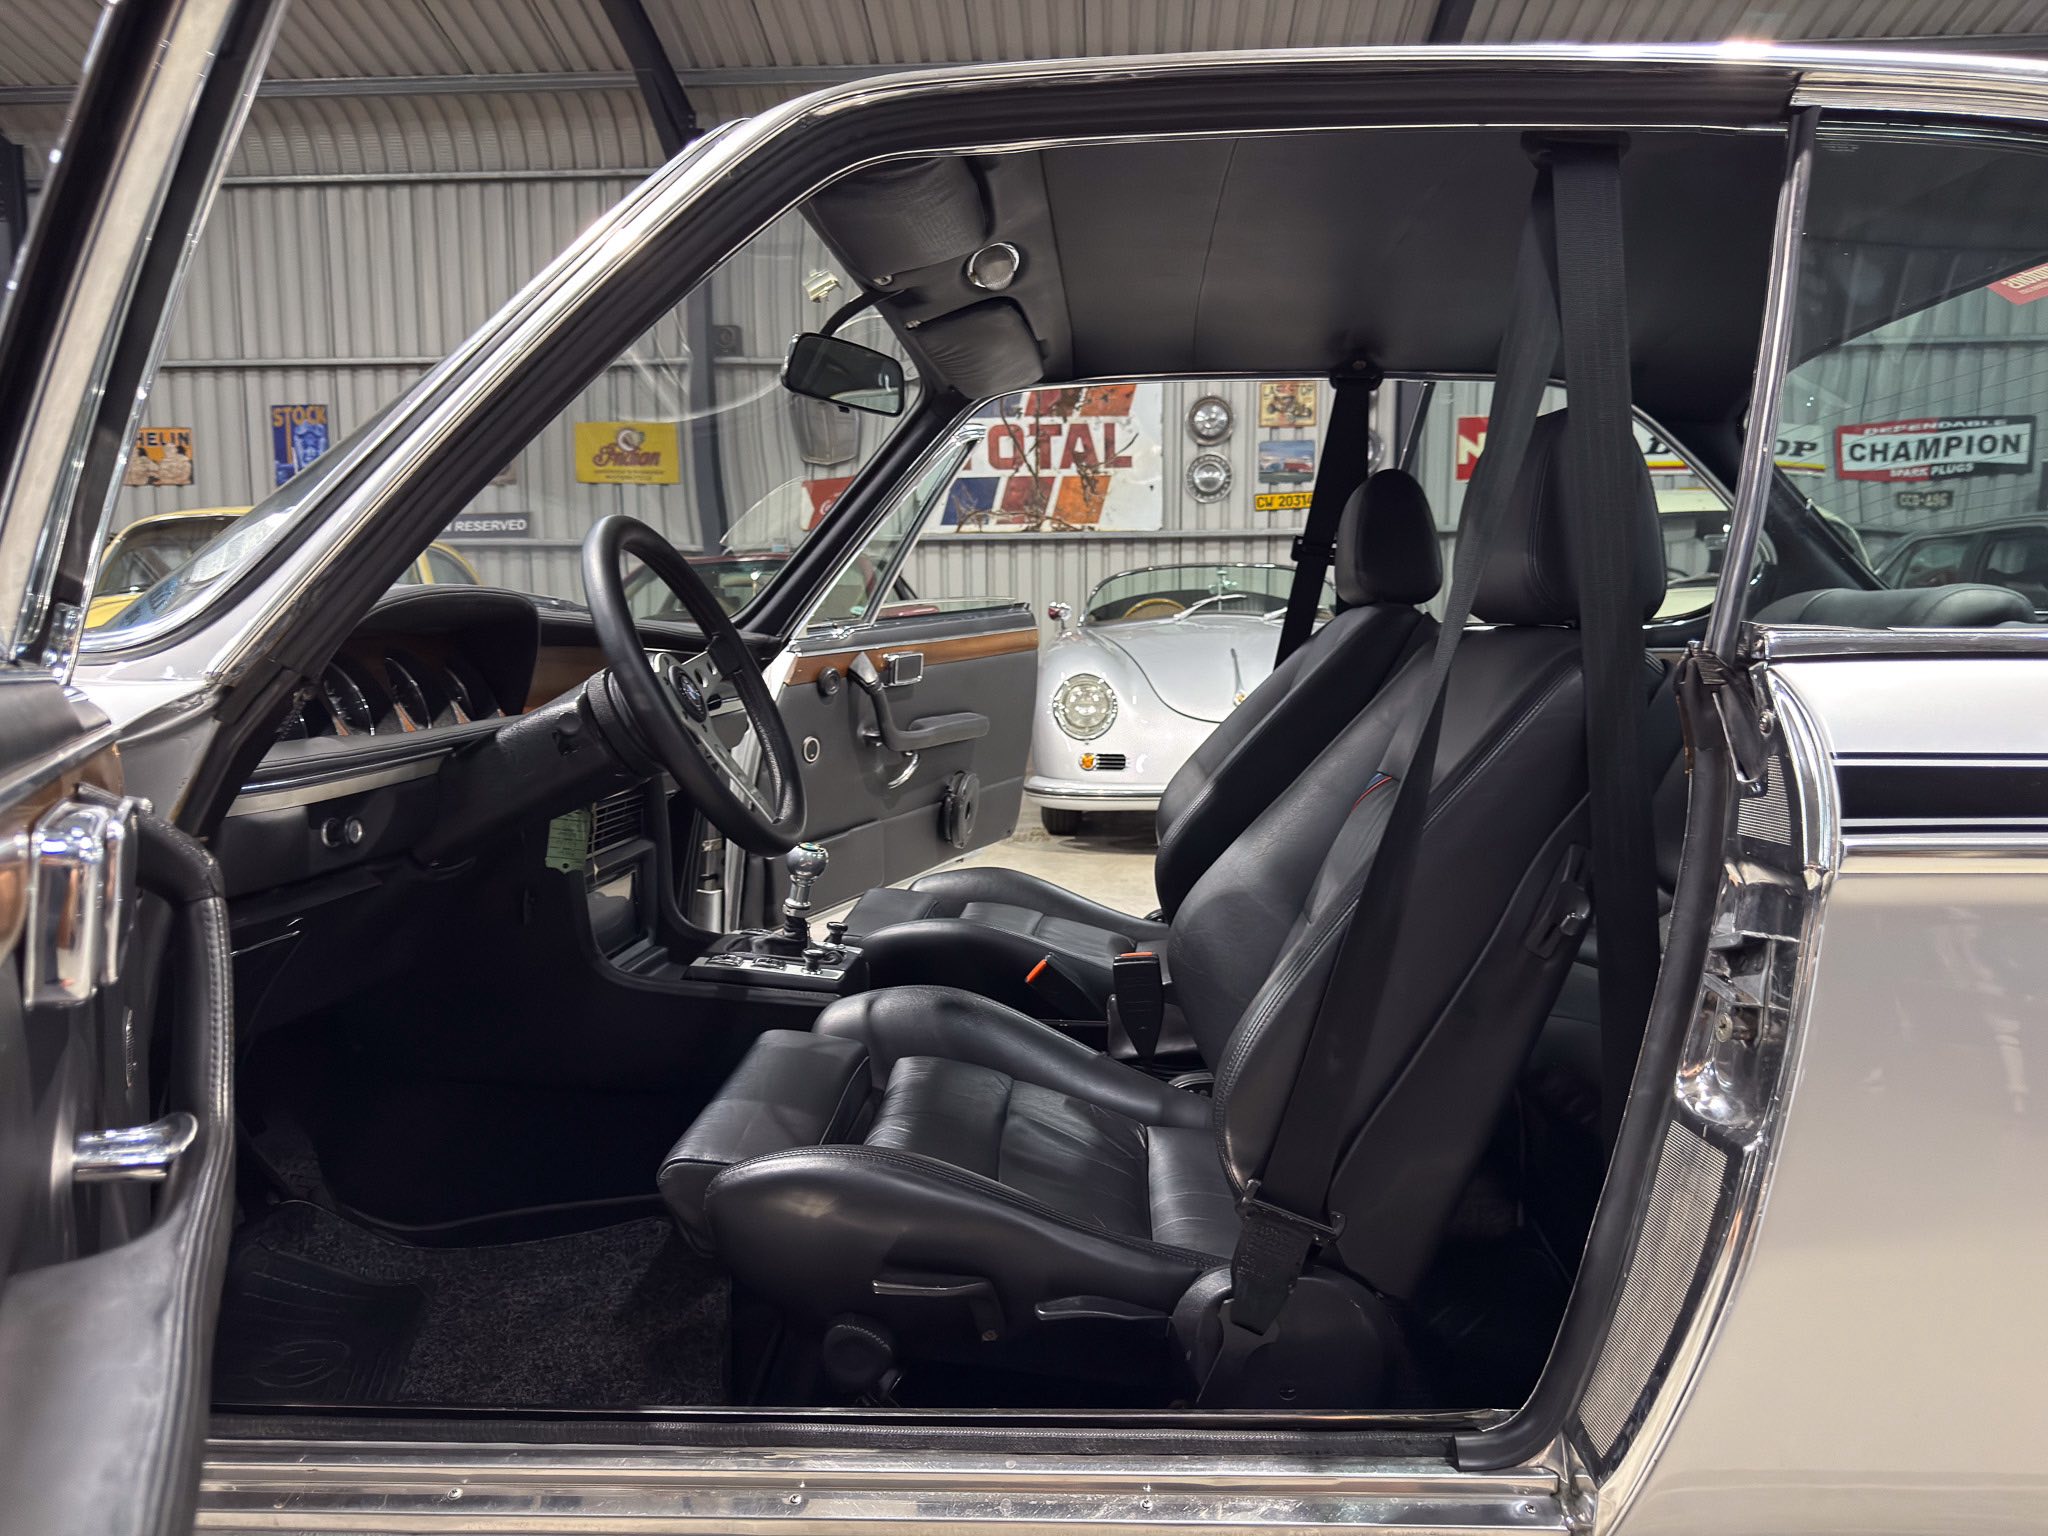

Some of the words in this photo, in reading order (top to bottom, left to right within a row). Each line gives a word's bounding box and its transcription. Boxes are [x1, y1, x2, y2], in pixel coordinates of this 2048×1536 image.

[273, 406, 327, 427] STOCK
[1863, 419, 2009, 436] DEPENDABLE
[963, 423, 1133, 470] OTAL
[1850, 434, 2021, 462] CHAMPION
[1890, 467, 1929, 477] SPARK
[1930, 463, 1974, 476] PLUGS
[455, 519, 527, 532] RESERVED
